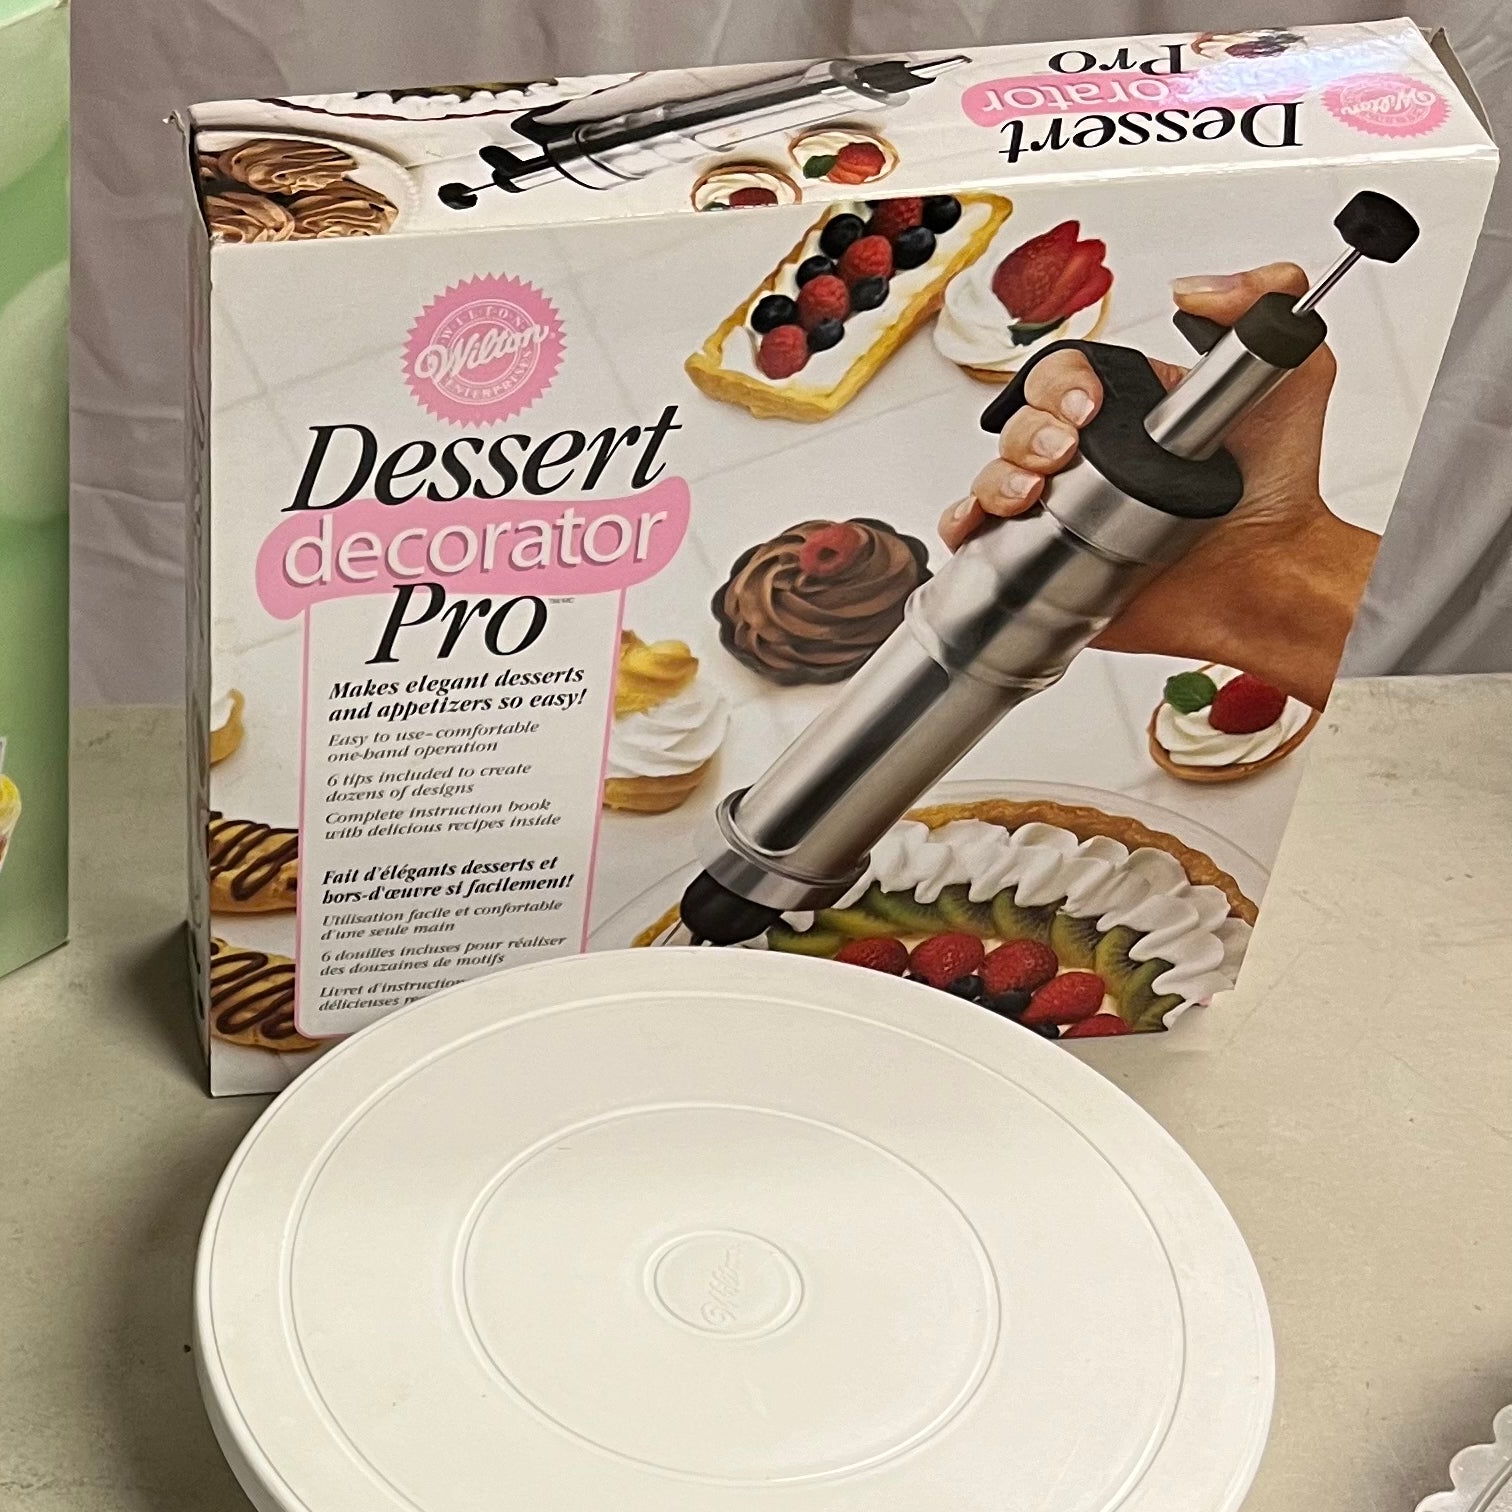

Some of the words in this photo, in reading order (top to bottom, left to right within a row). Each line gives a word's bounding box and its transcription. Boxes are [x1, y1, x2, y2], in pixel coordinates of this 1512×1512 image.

[1048, 43, 1187, 76] Pro
[999, 101, 1304, 163] Dessert
[414, 324, 549, 380] Wilton
[282, 405, 683, 513] Dessert
[284, 507, 668, 588] decorator
[365, 582, 548, 665] Pro
[328, 679, 399, 700] Makes
[406, 672, 489, 696] elegant
[494, 667, 585, 688] desserts
[329, 701, 371, 722] and
[377, 696, 493, 722] appetizers
[498, 697, 524, 710] so
[529, 688, 588, 711] easy!
[328, 734, 368, 748] Easy
[373, 731, 390, 743] to
[328, 747, 410, 763] one-hand
[414, 741, 499, 759] operation
[327, 774, 338, 787] 6
[343, 773, 373, 788] tips
[379, 767, 452, 784] included
[458, 767, 475, 778] to
[480, 763, 532, 776] create
[325, 788, 384, 803] dozens
[389, 785, 410, 800] of
[411, 782, 474, 797] designs
[325, 809, 404, 825] Complete
[409, 803, 503, 819] instruction
[508, 798, 551, 812] book
[325, 827, 362, 840] with
[367, 822, 442, 837] delicious
[447, 816, 505, 833] recipes
[509, 814, 562, 827] inside
[322, 868, 359, 886] Fait
[363, 862, 457, 883] d'élégants
[461, 858, 534, 877] desserts
[539, 856, 558, 870] et
[445, 881, 463, 895] si
[463, 873, 574, 899] facilement!
[322, 909, 403, 928] Utilisation
[407, 907, 450, 924] facile
[454, 907, 470, 917] et
[473, 900, 563, 917] confortable
[320, 928, 365, 941] d'une
[367, 924, 409, 937] seule
[413, 921, 455, 934] main
[320, 950, 331, 963] 6
[335, 946, 395, 962] douilles
[399, 943, 461, 957] incluses
[464, 940, 503, 955] pour
[507, 935, 567, 949] réaliser
[319, 964, 345, 977] des
[349, 958, 429, 974] douzaines
[432, 956, 451, 968] de
[456, 953, 504, 966] motifs
